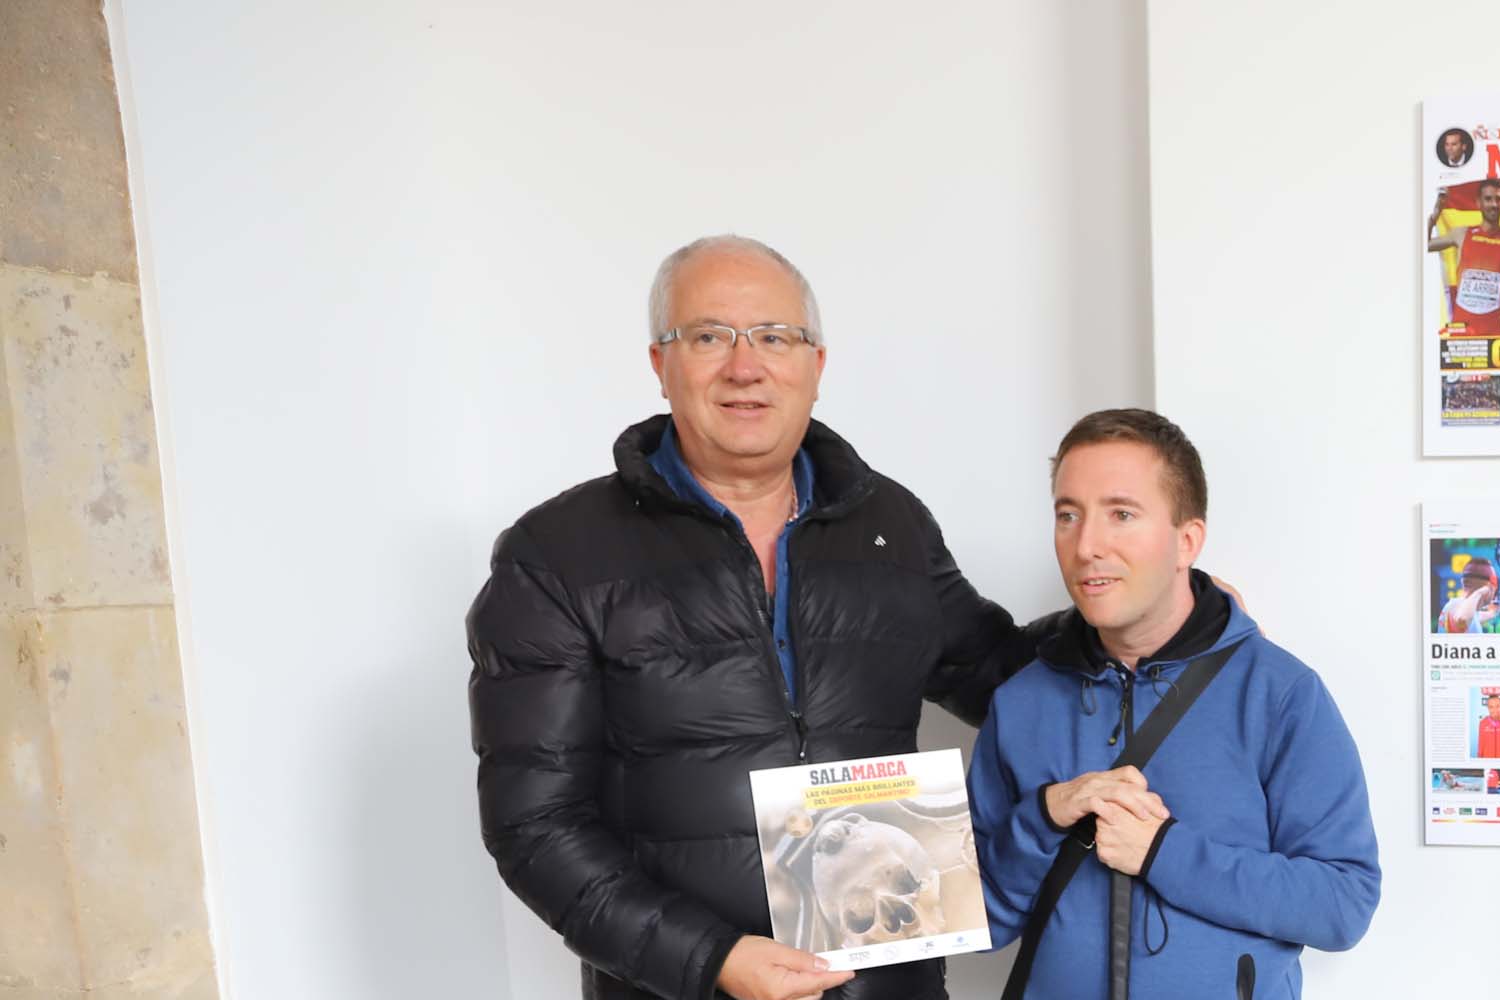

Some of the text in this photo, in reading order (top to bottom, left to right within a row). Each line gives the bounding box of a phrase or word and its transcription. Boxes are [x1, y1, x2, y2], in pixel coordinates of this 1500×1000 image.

[1431, 643, 1481, 660] Diana
[1486, 647, 1495, 660] a
[810, 760, 907, 786] SALAMARCA
